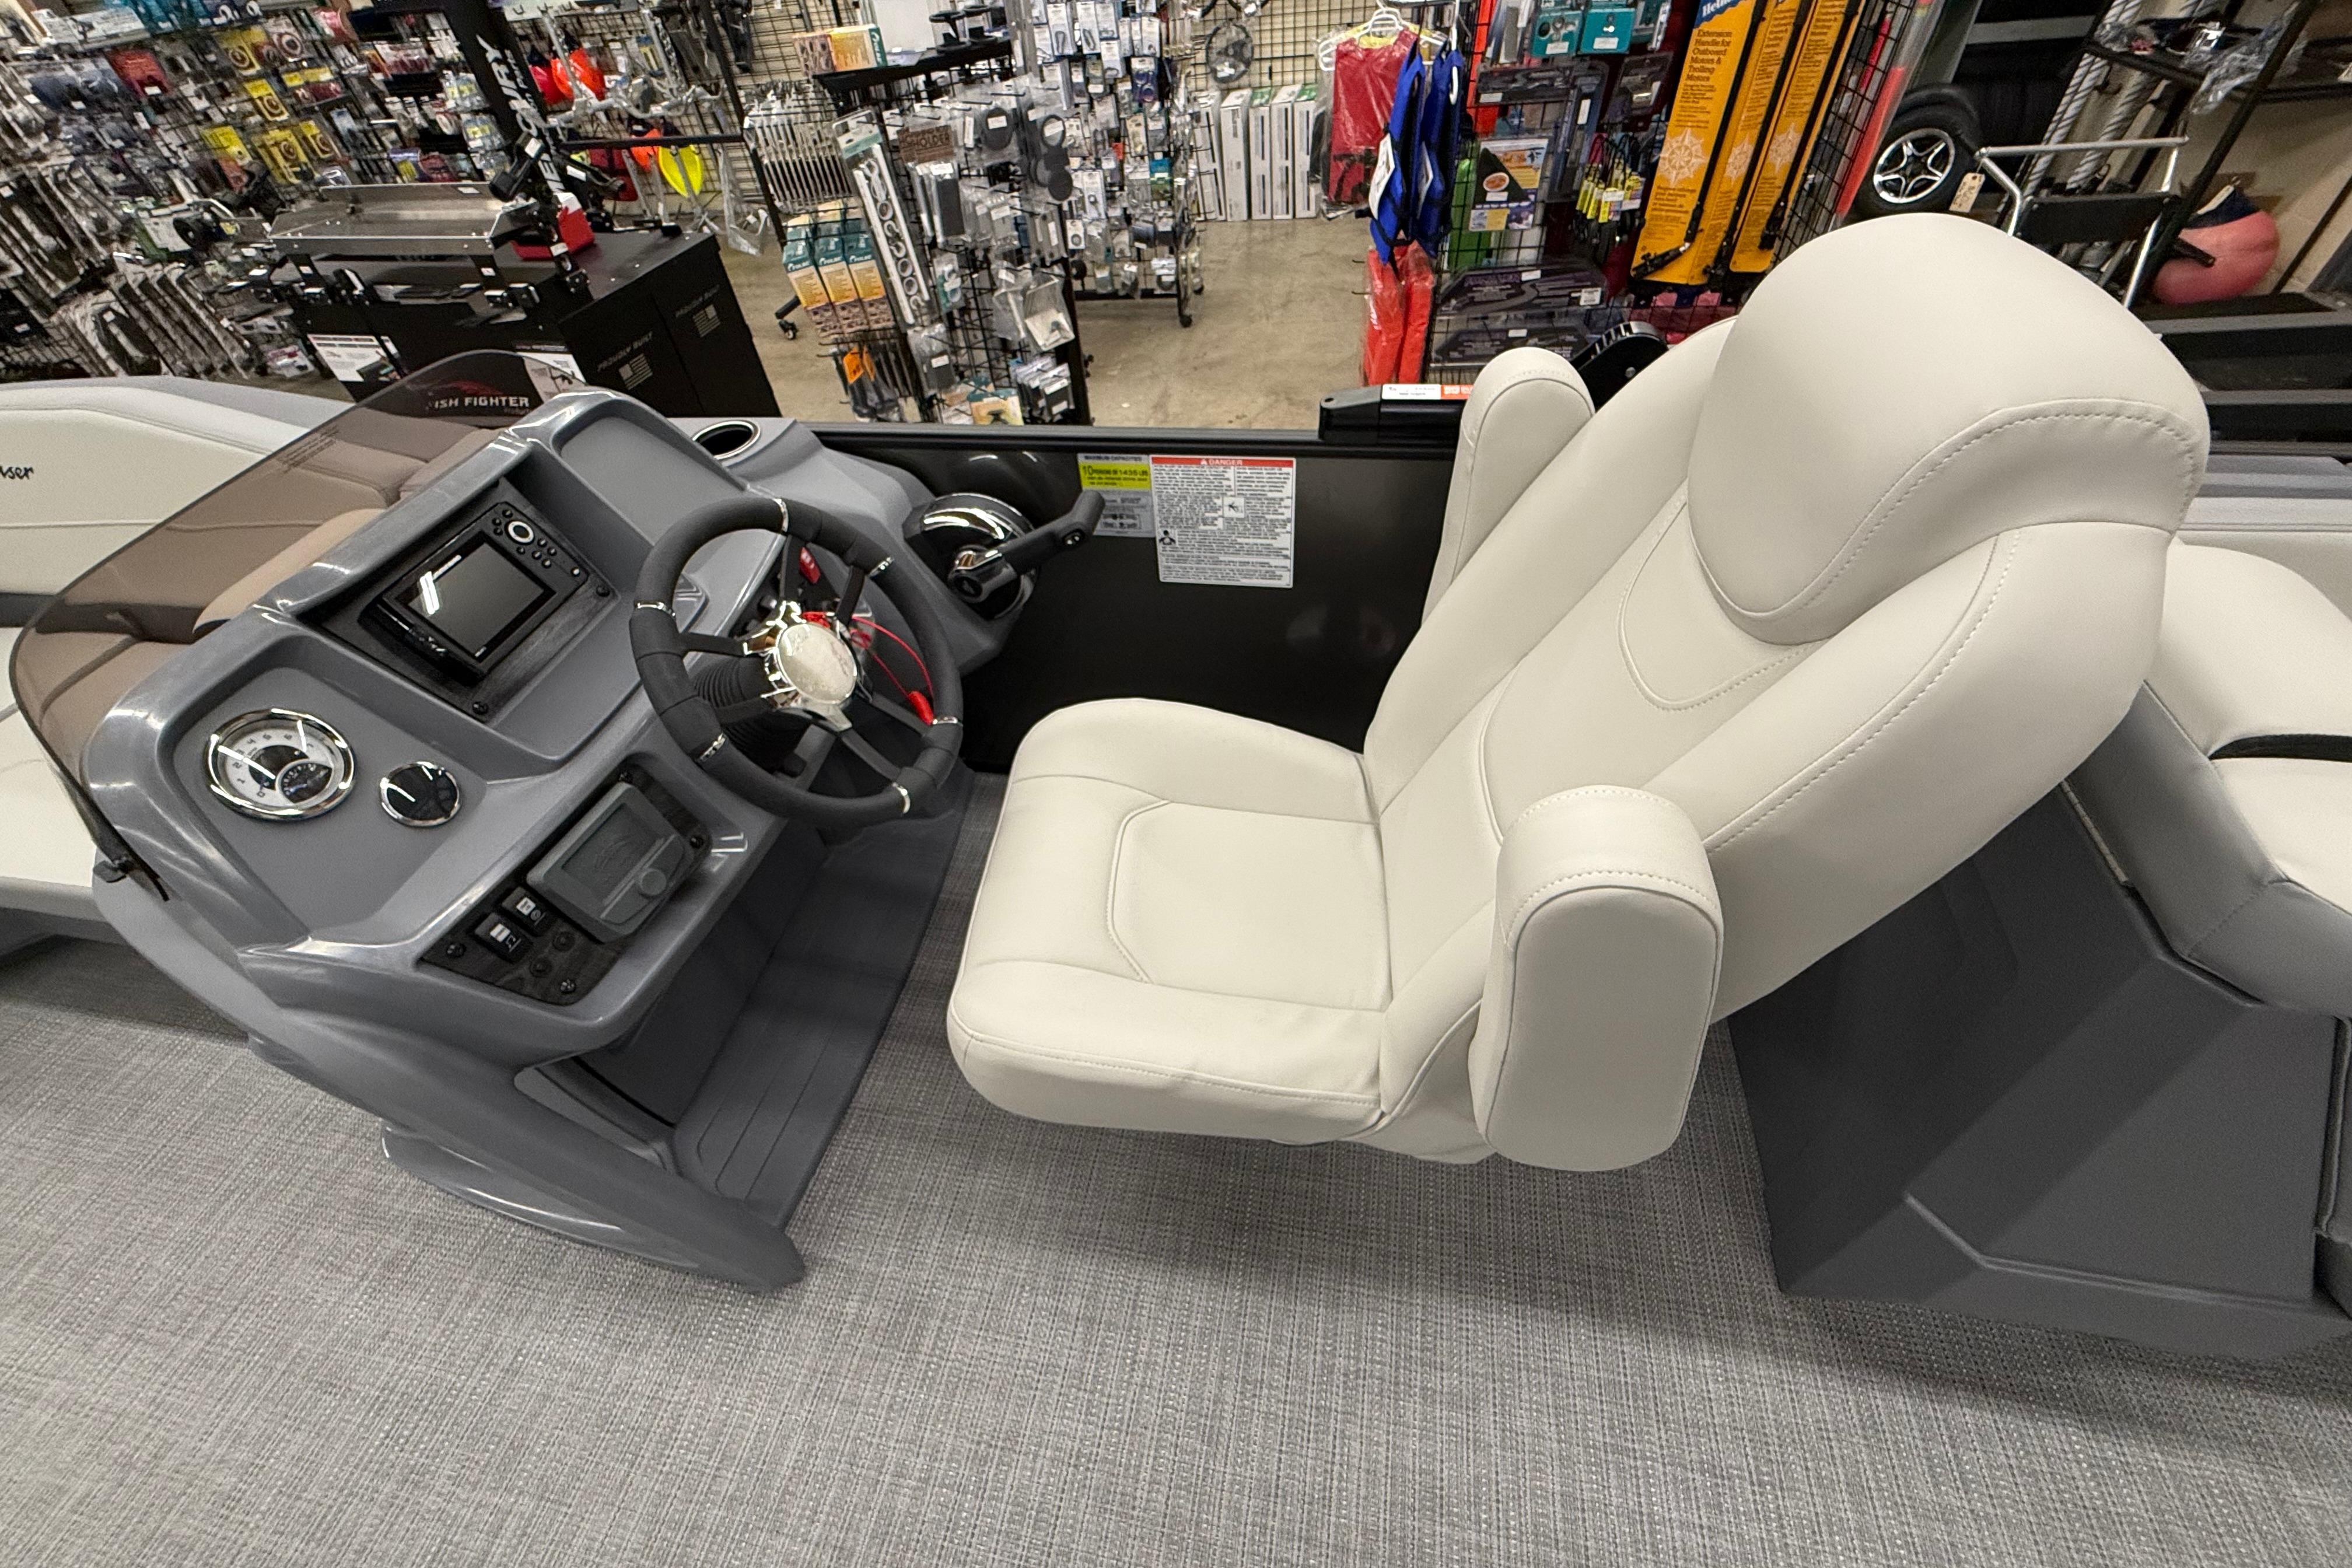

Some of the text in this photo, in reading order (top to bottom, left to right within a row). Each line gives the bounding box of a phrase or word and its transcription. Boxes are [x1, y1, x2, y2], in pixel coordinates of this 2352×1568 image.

[1698, 29, 1732, 37] Extension
[1688, 65, 1715, 75] Trolling
[464, 396, 530, 408] FIGHTER
